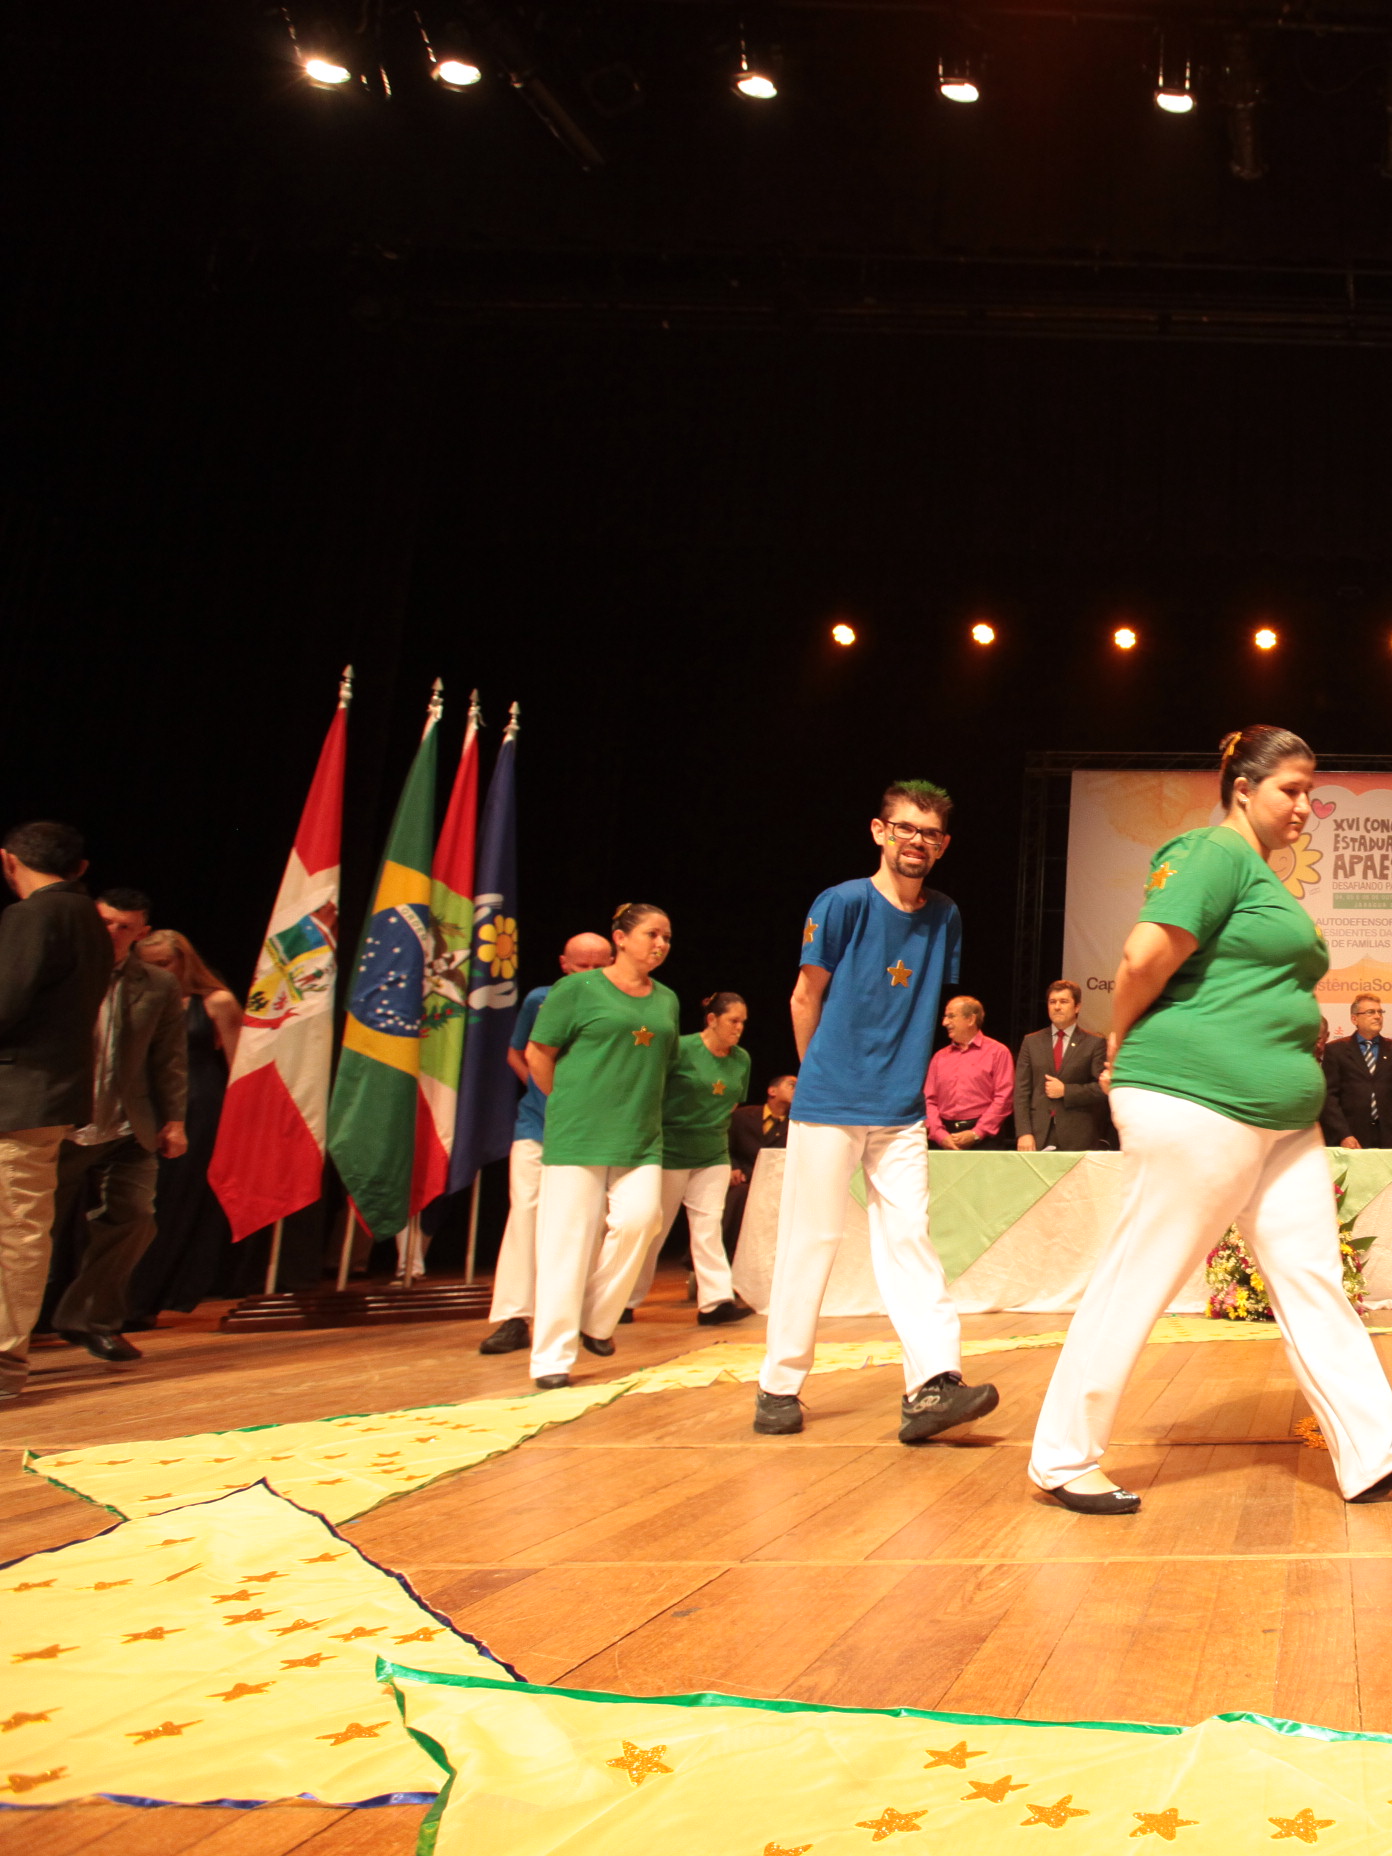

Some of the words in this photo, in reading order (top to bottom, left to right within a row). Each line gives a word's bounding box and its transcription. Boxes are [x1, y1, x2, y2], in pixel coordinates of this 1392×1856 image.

[1333, 817, 1360, 831] XVI
[1332, 882, 1382, 890] DESAFIANDO
[1321, 929, 1377, 938] ESIDENTES
[1332, 939, 1344, 948] DE
[1086, 977, 1115, 994] Cap
